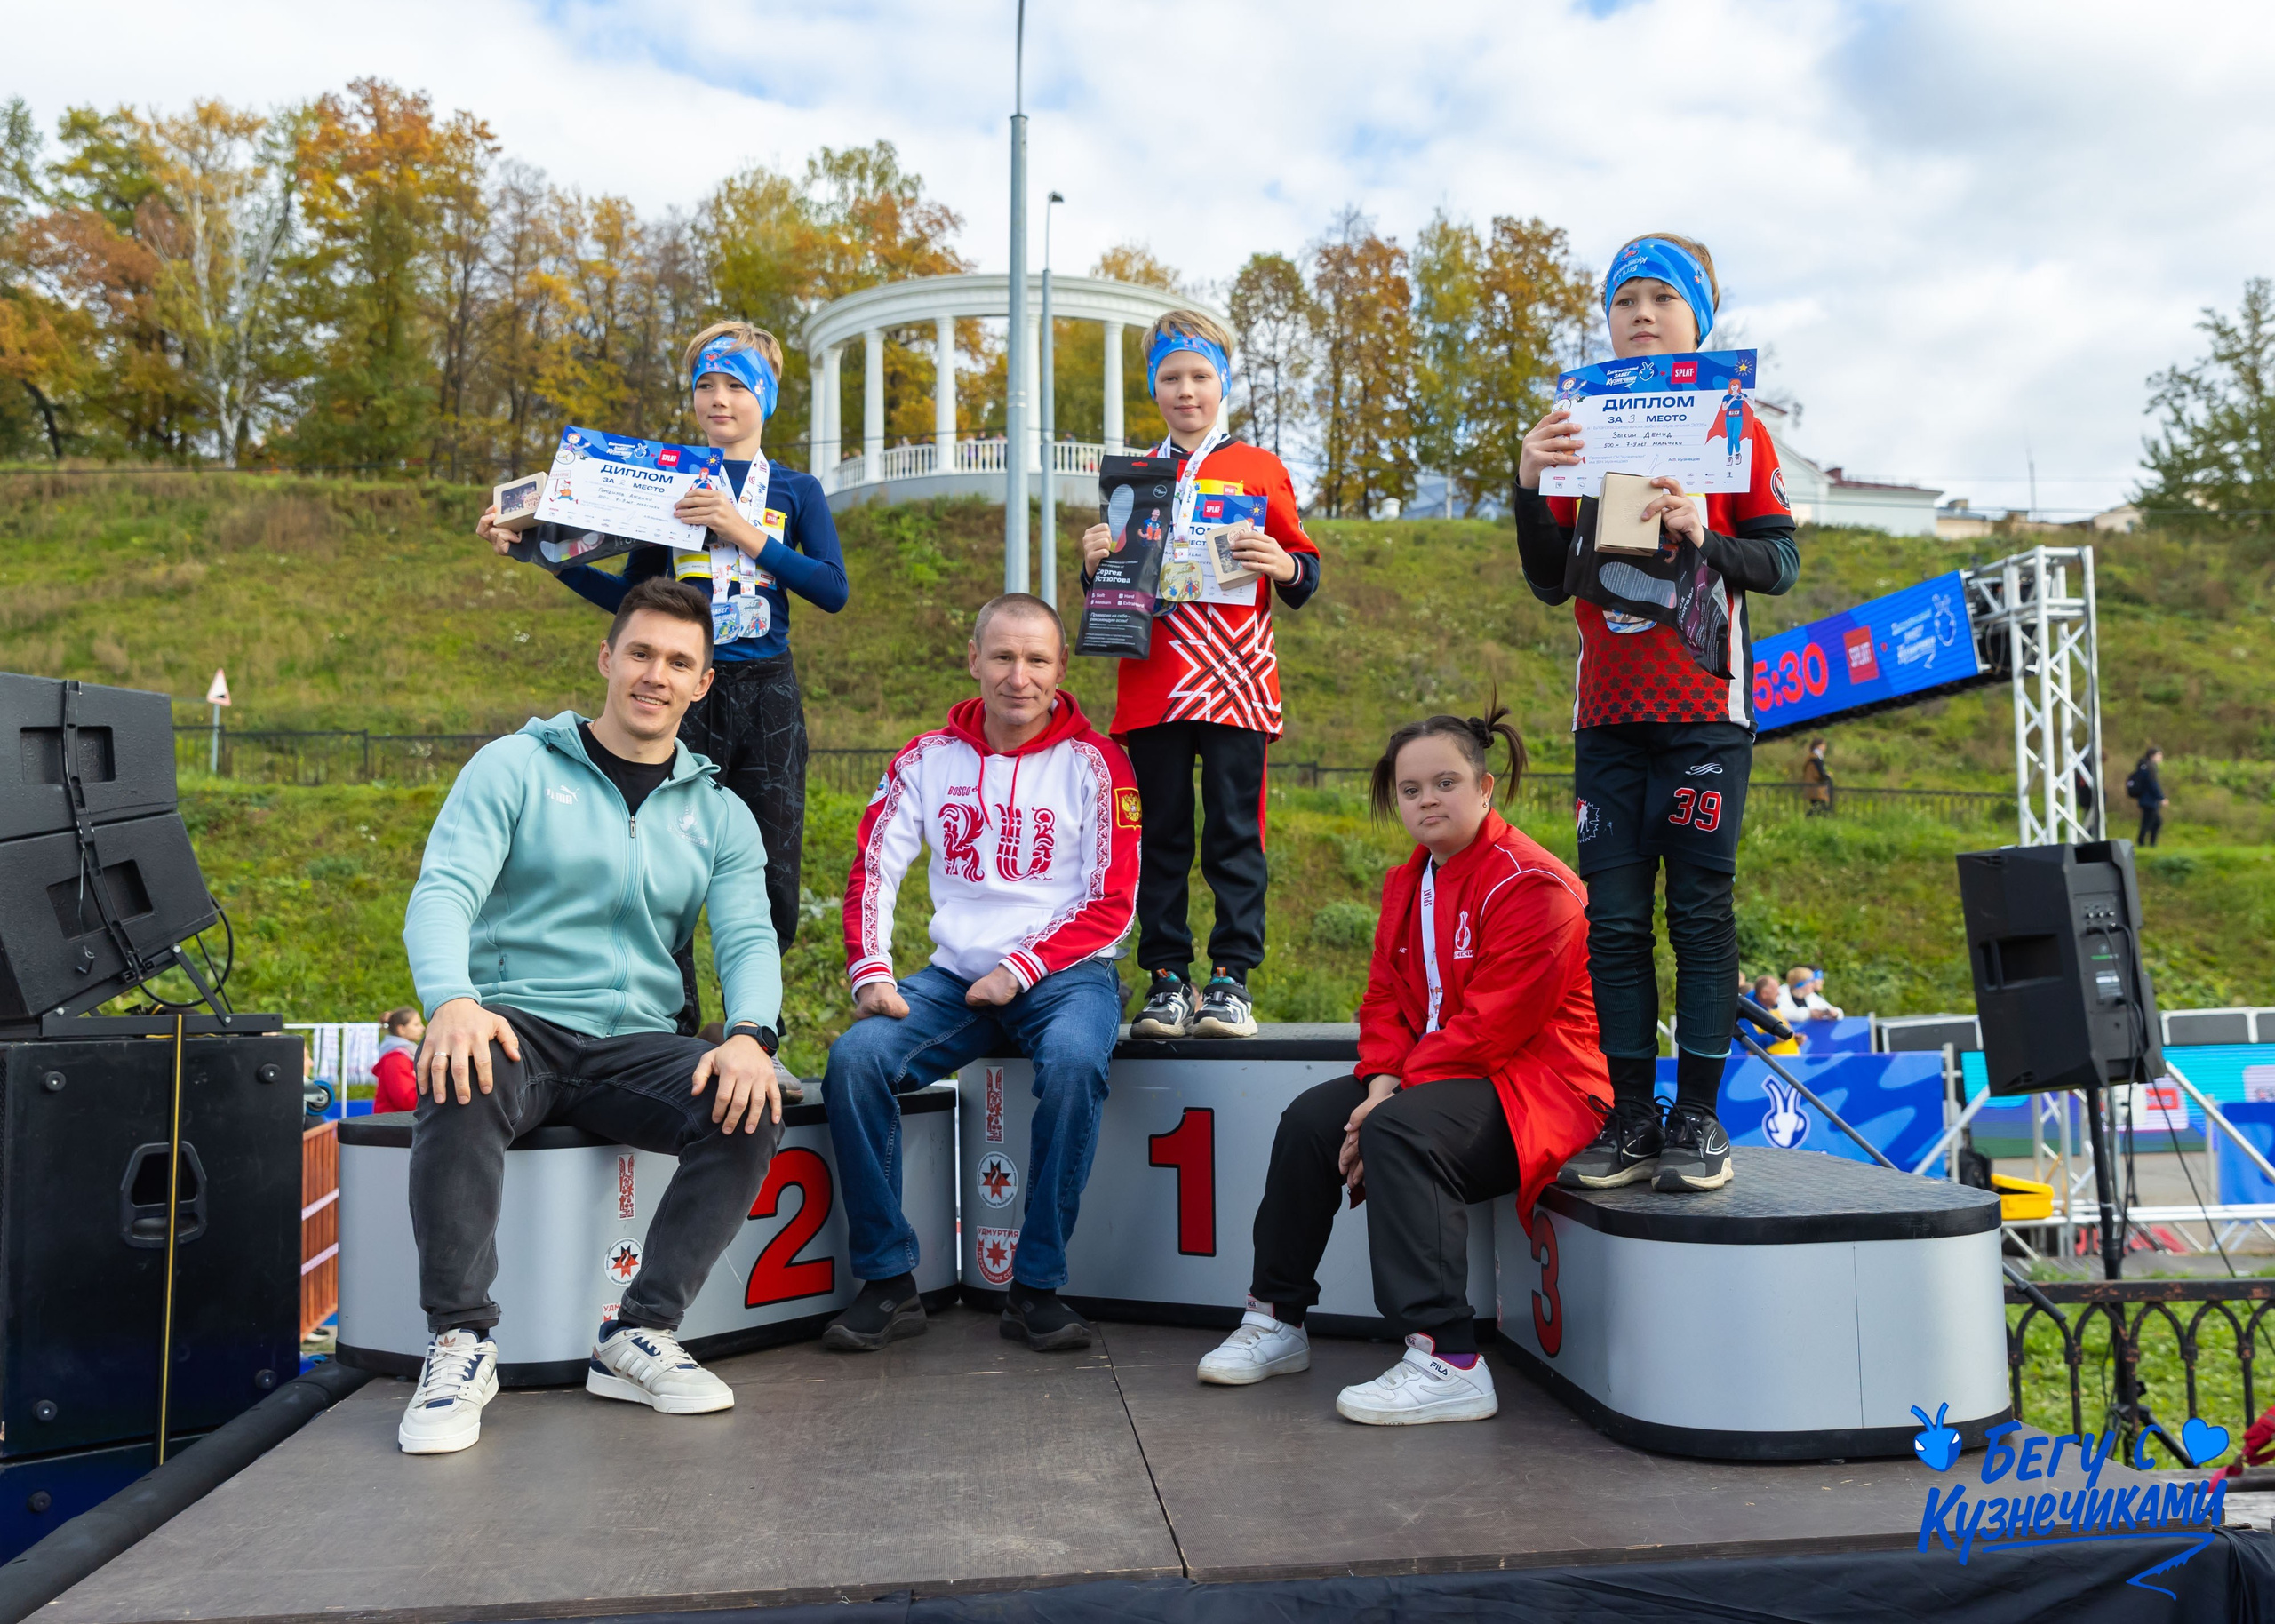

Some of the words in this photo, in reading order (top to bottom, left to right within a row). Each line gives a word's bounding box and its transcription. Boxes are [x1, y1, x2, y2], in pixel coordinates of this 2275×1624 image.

[1675, 368, 1694, 377] SPLAT
[1602, 396, 1695, 411] ДИПЛОМ
[1628, 414, 1636, 423] 3
[1646, 414, 1688, 423] МЕСТО
[601, 464, 674, 484] ДИПЛОМ
[633, 482, 666, 493] МЕСТО
[947, 786, 970, 796] BOSCO
[1668, 787, 1722, 832] 39
[1148, 1107, 1217, 1257] 1
[745, 1146, 834, 1310] 2
[978, 1228, 1019, 1238] УДМУРТИЯ
[1530, 1210, 1562, 1358] 3
[1430, 1361, 1448, 1376] FILA
